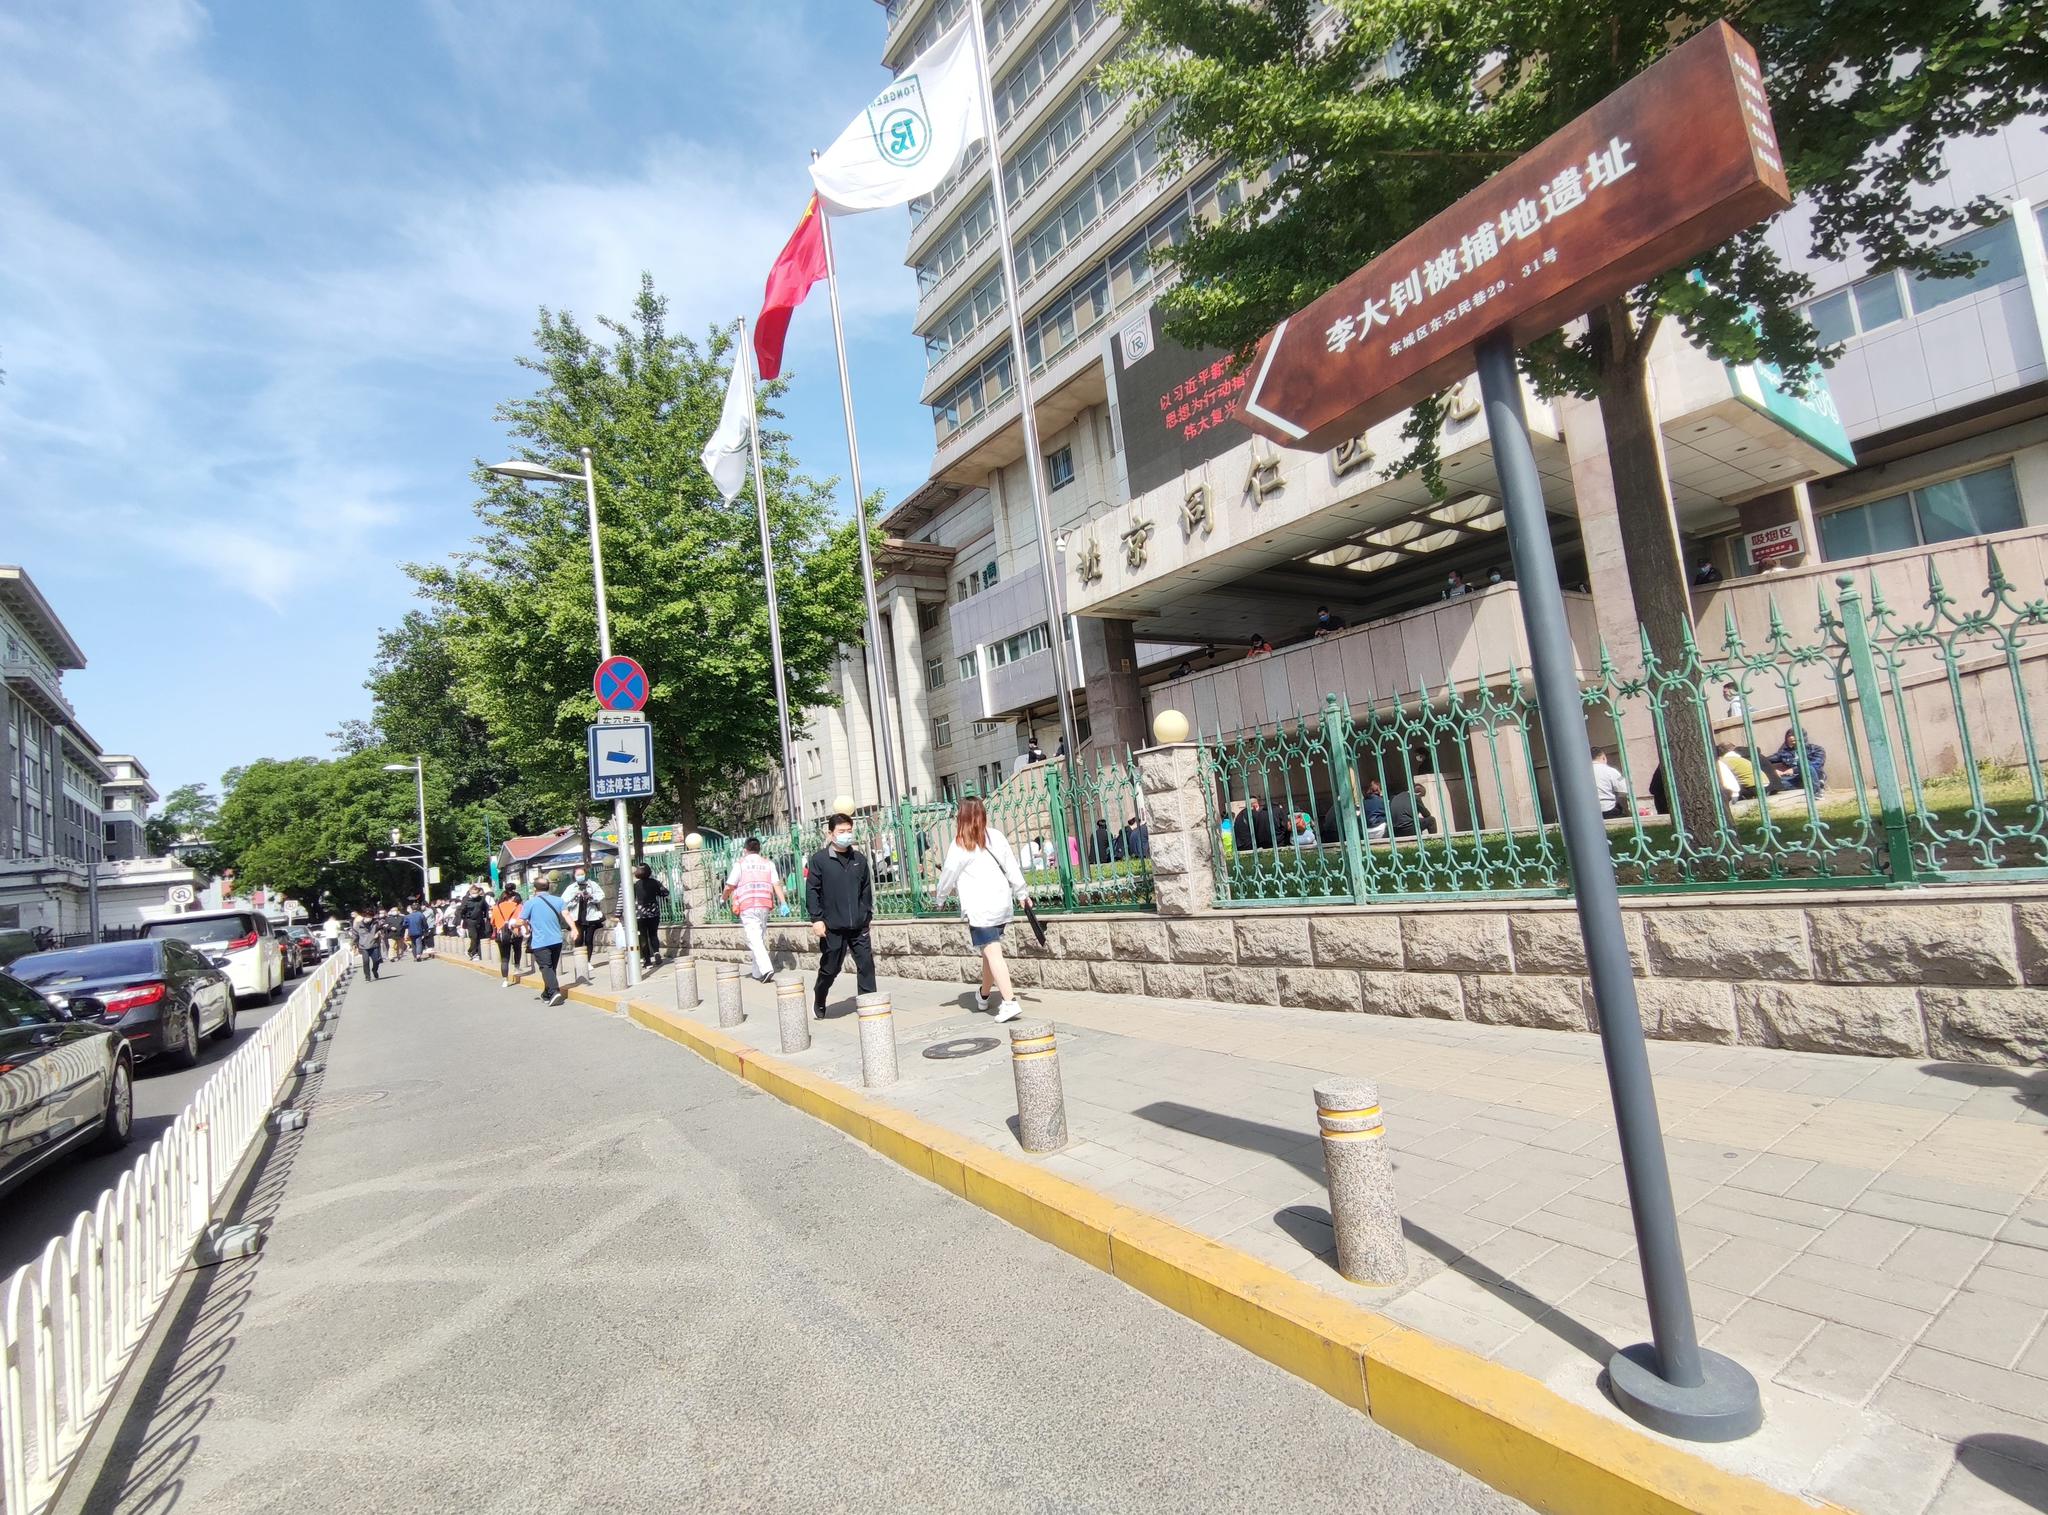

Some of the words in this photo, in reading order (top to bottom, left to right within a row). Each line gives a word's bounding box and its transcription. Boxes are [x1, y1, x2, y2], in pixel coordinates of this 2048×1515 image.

[1325, 136, 1638, 354] 李大钊被捕地遗址
[1388, 247, 1559, 357] 东城区东交民巷29、31号
[1165, 366, 1251, 429] 思想为行动指
[1751, 526, 1793, 546] 吸烟区
[596, 775, 651, 794] 违法停车监测
